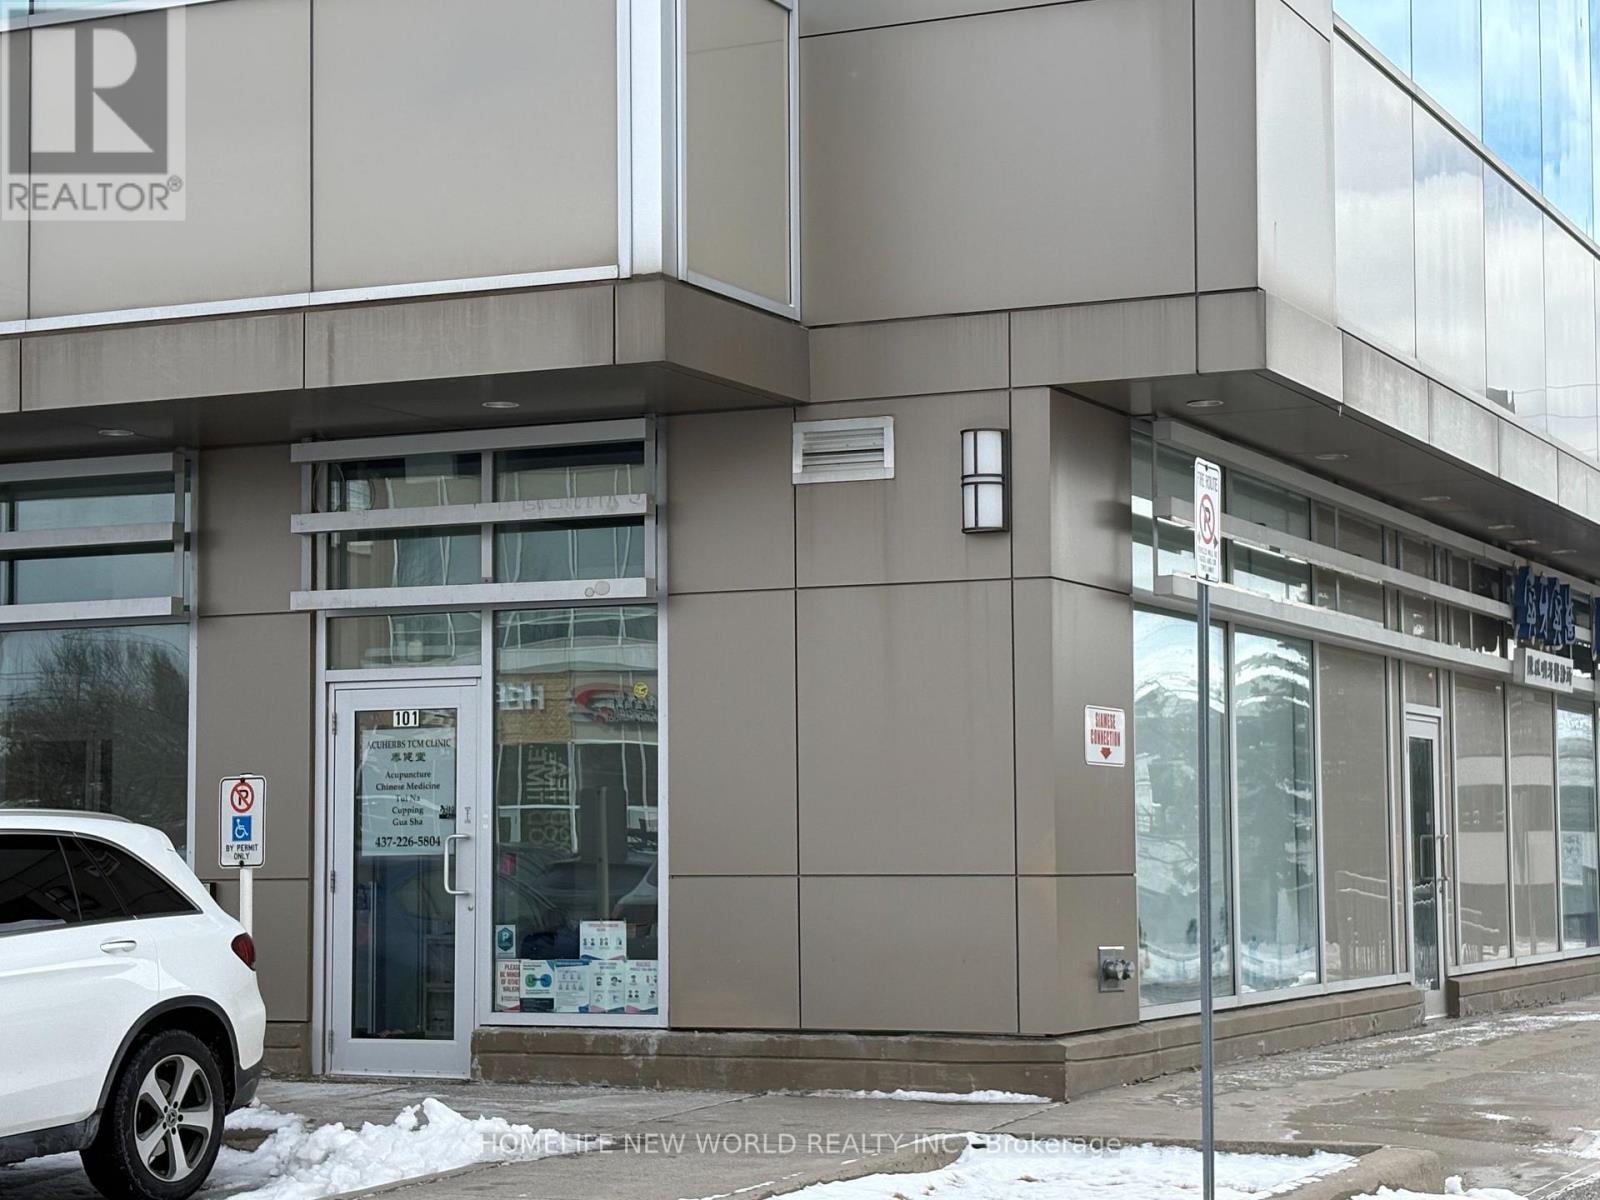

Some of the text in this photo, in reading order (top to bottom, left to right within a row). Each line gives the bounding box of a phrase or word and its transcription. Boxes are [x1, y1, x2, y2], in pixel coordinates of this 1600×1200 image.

[395, 710, 418, 726] 101
[1091, 729, 1121, 747] CONNECTION
[408, 739, 425, 749] TCM
[425, 738, 452, 748] CLINIC
[385, 771, 432, 780] Acupuncture
[375, 782, 441, 791] Chinese Medicine
[391, 807, 424, 816] Cupping
[392, 818, 423, 826] Gua Sha
[375, 836, 441, 848] 437-226-5804
[225, 843, 258, 852] BY PERMIT
[233, 852, 250, 860] ONLY
